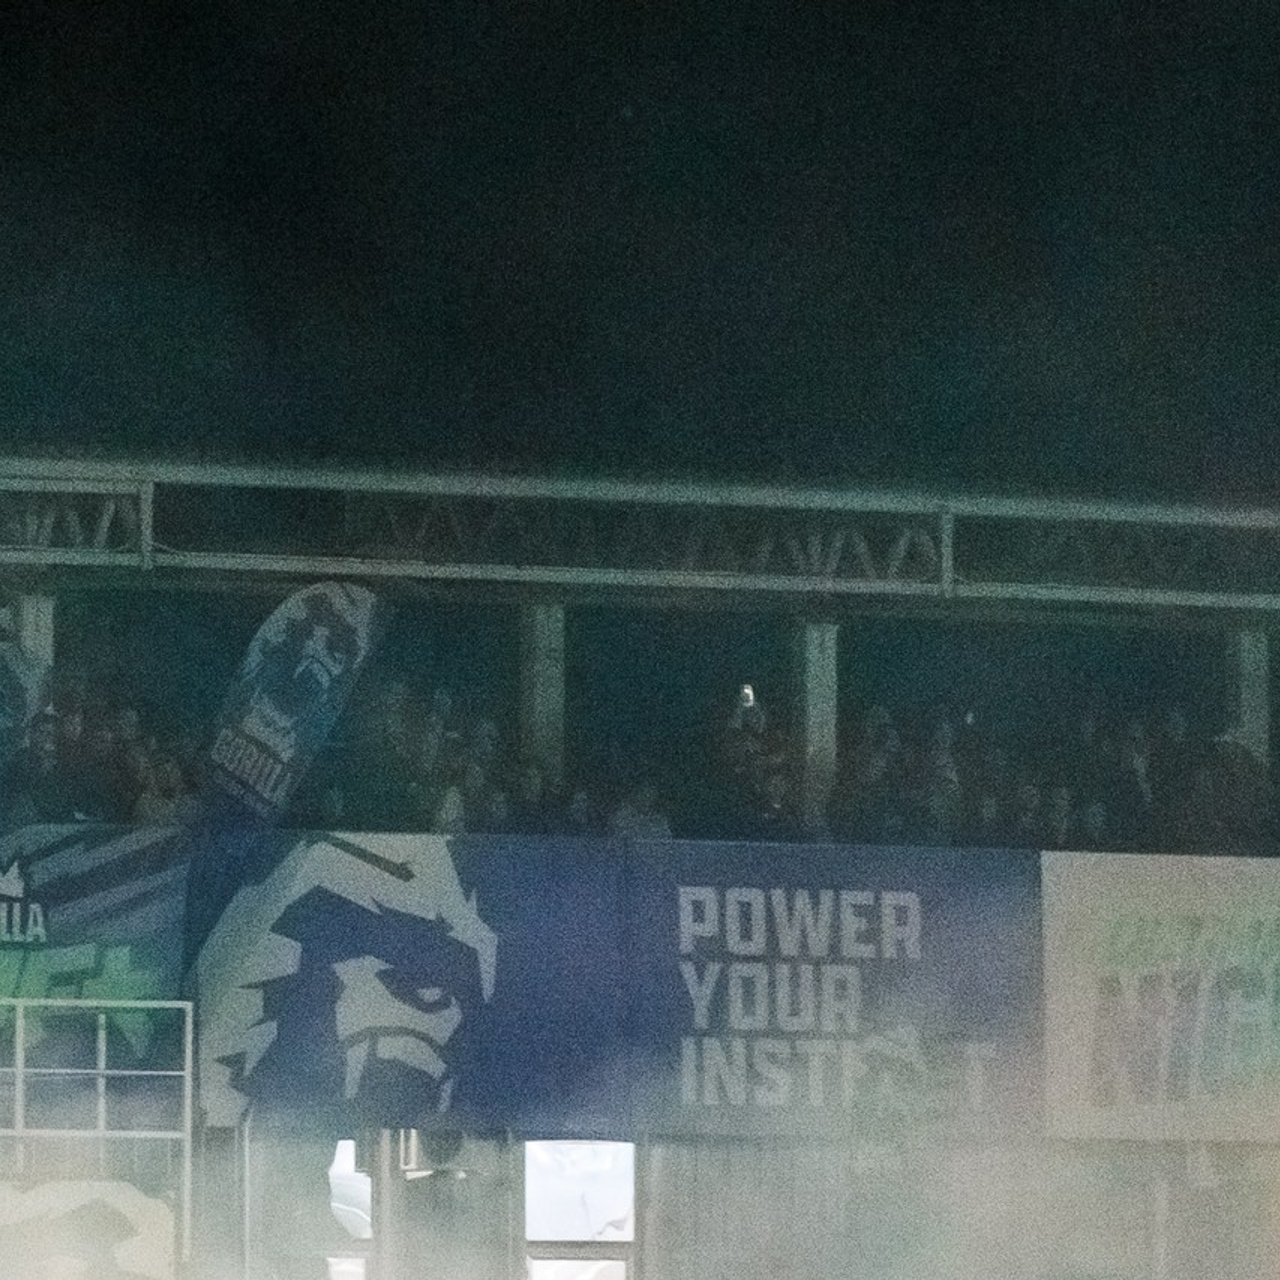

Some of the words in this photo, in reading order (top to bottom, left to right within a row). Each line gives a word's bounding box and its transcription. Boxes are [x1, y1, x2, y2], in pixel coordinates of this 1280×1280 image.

[678, 886, 920, 958] POWER
[679, 961, 862, 1032] YOUR
[680, 1037, 997, 1106] INSTIT
